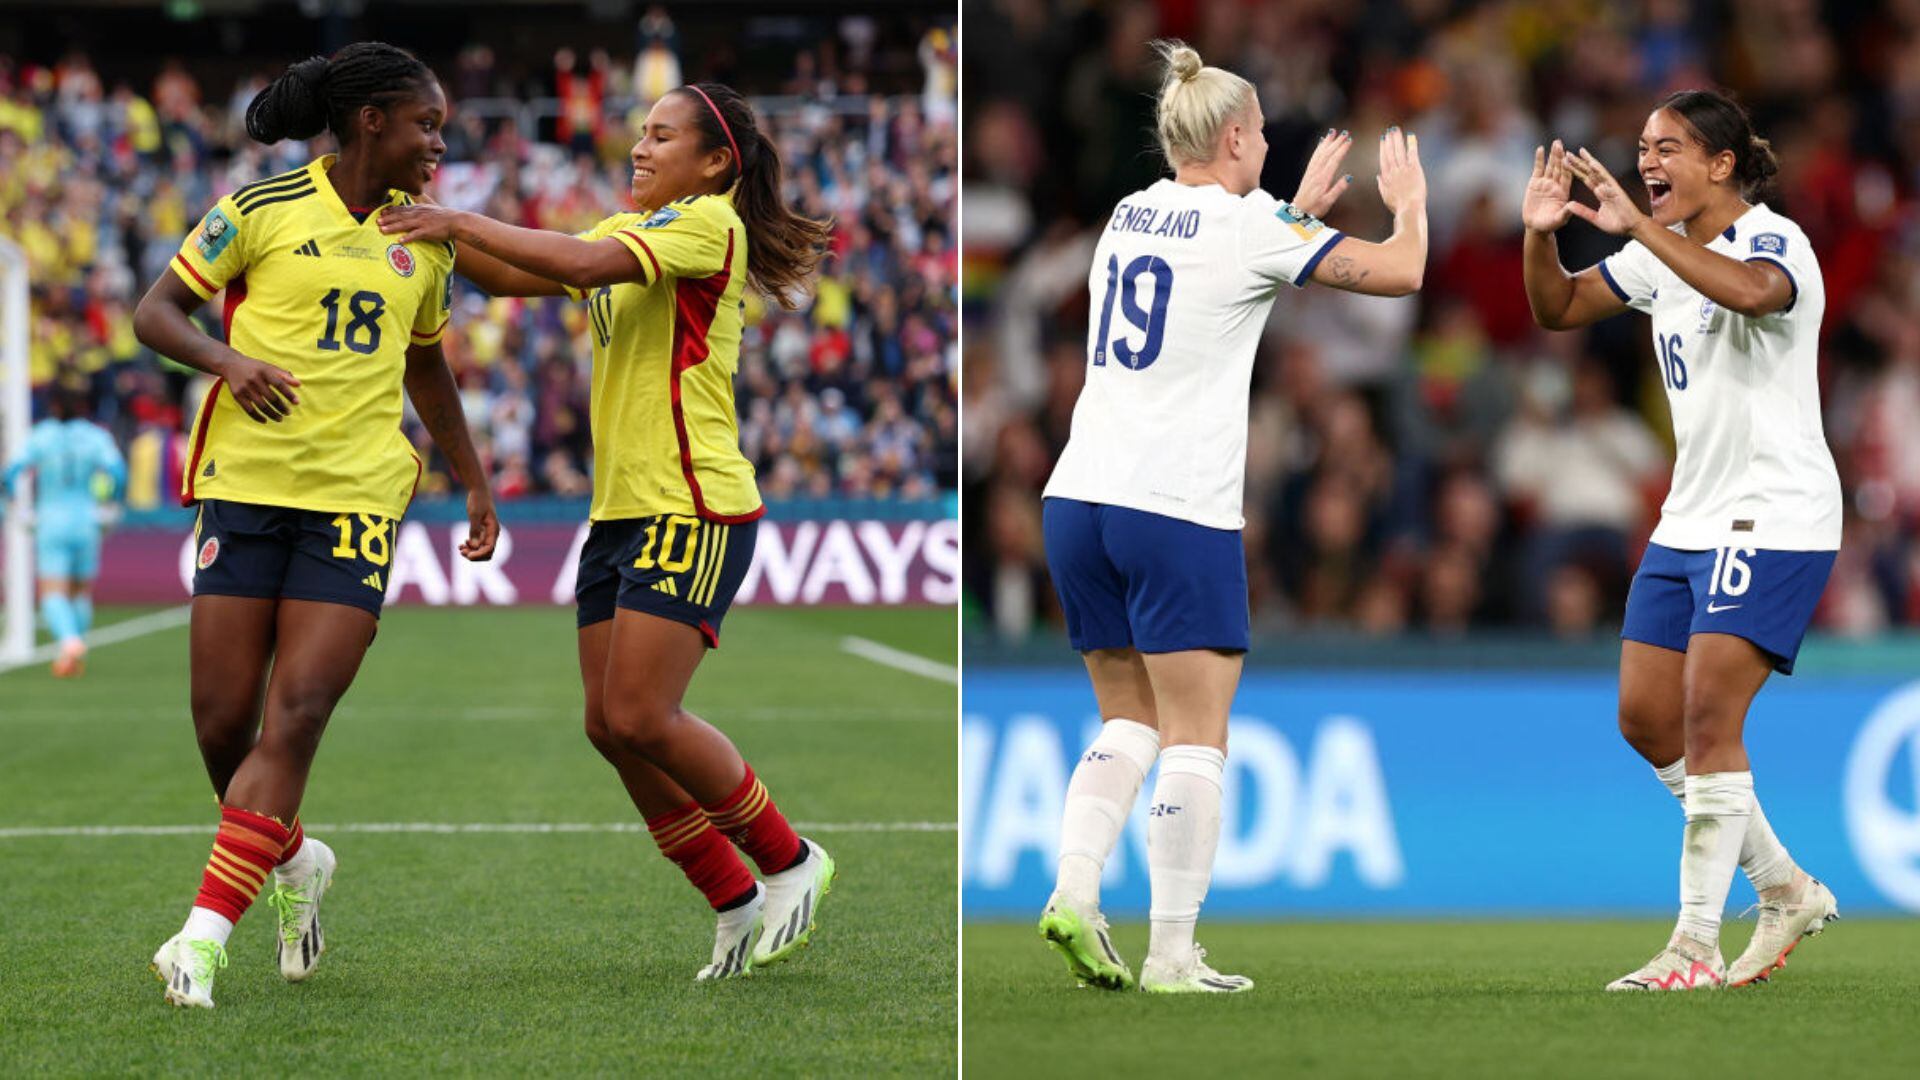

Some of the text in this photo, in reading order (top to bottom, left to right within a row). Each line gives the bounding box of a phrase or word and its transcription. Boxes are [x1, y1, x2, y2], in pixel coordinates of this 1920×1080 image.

[1112, 204, 1200, 239] ENGLAND
[317, 288, 386, 354] 18
[1093, 253, 1174, 371] 19
[1658, 331, 1688, 391] 16
[331, 513, 391, 566] 18
[633, 514, 701, 573] 10
[1708, 547, 1757, 596] 16
